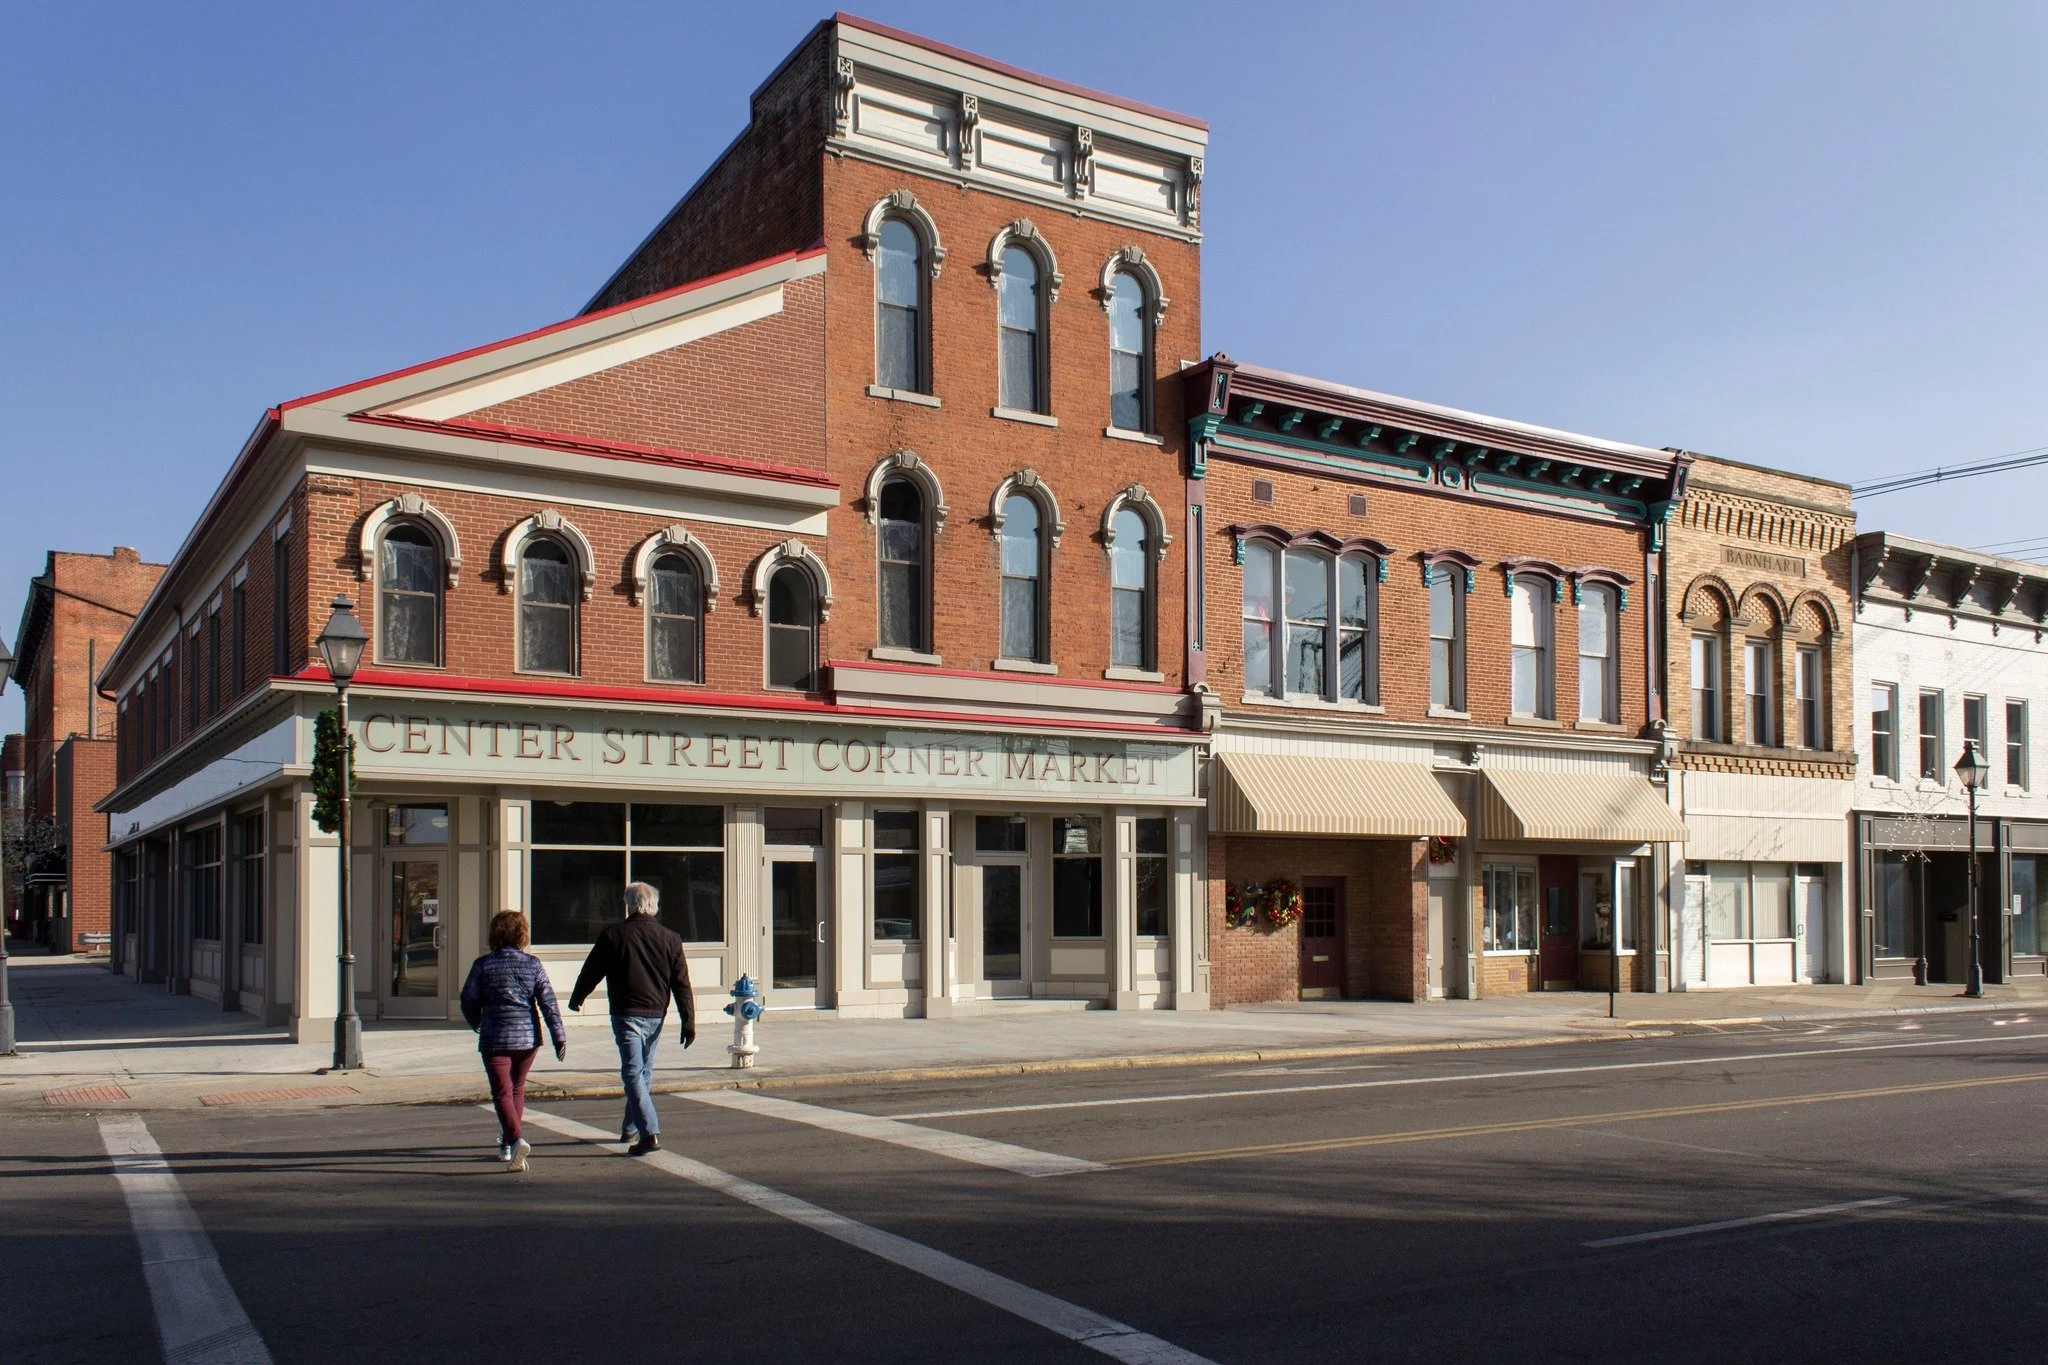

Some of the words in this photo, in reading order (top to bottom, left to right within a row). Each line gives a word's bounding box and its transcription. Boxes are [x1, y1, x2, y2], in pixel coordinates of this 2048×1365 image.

[1726, 549, 1800, 574] BARNHART
[361, 713, 582, 762] CENTER
[601, 726, 796, 770] STREET
[812, 736, 988, 776] CORNER
[1004, 748, 1163, 786] MARKET
